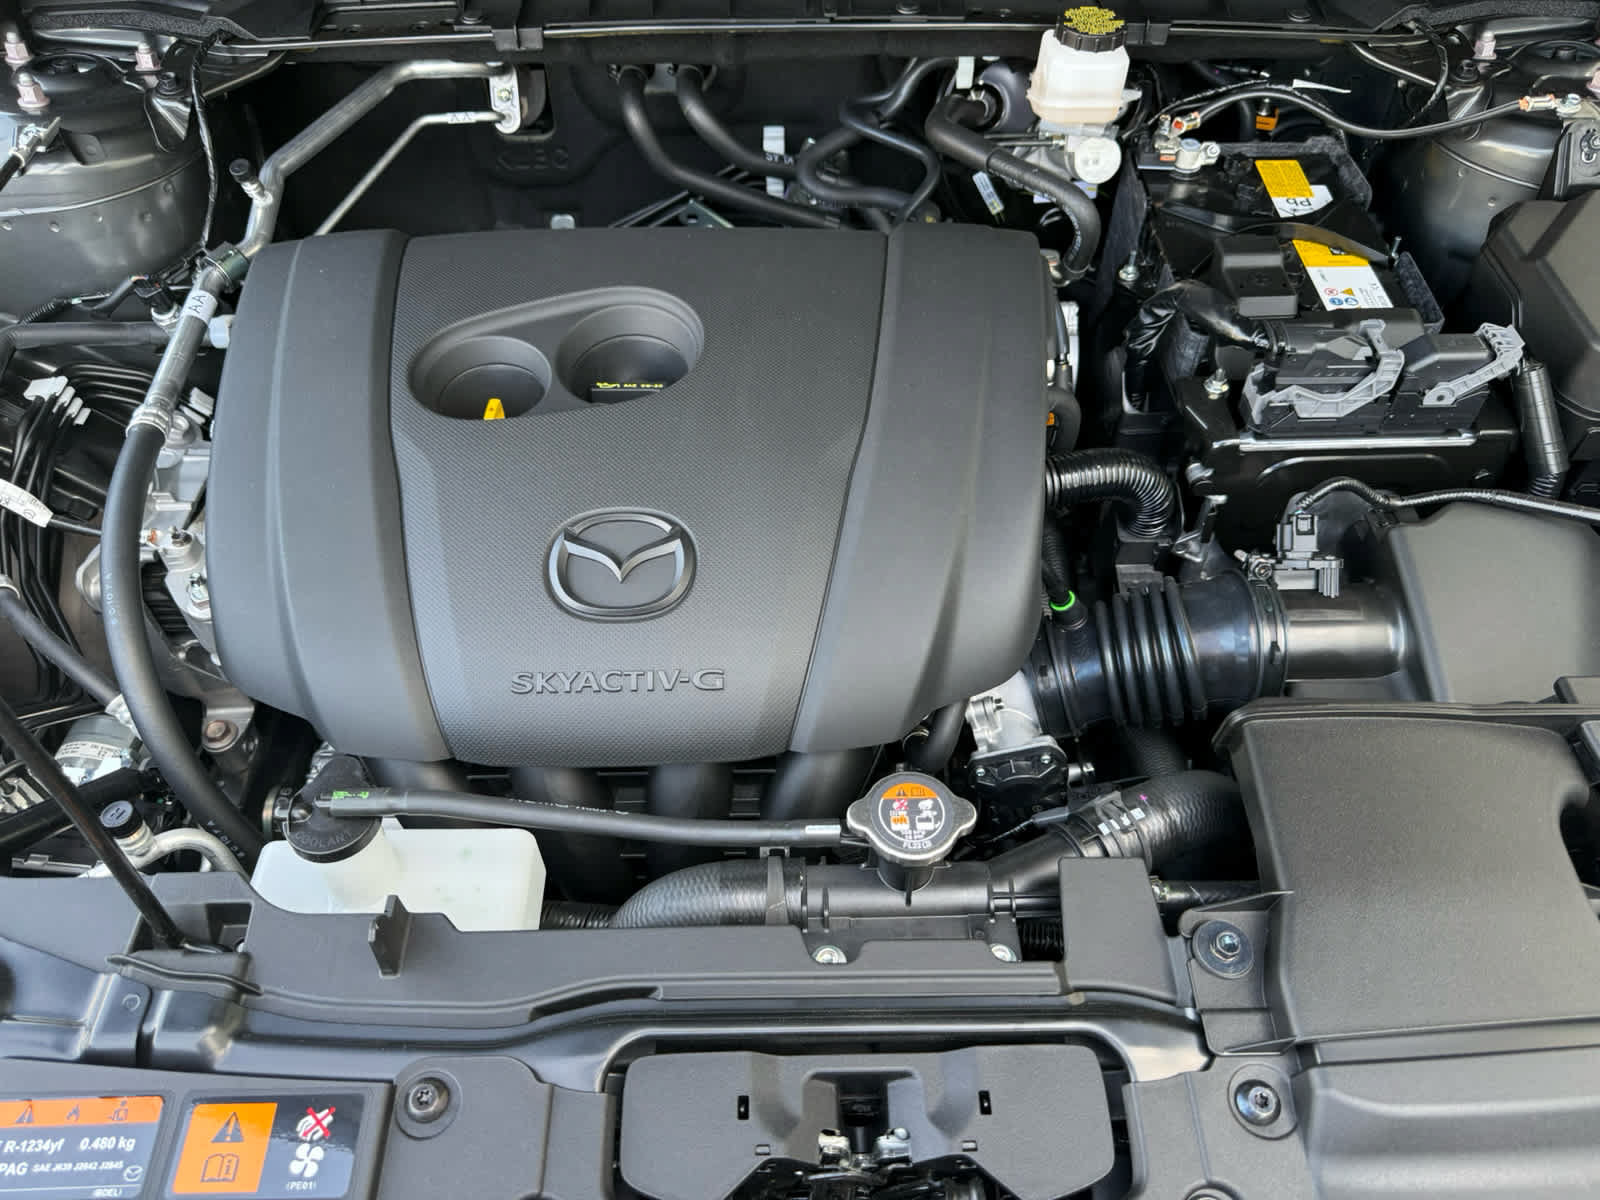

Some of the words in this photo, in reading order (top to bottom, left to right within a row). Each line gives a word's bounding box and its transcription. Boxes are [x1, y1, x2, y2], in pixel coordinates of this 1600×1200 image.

[510, 668, 726, 695] SKYACTIV-G
[3, 1137, 65, 1155] R-1234yf
[118, 1135, 136, 1152] kg
[0, 1161, 29, 1176] PAG
